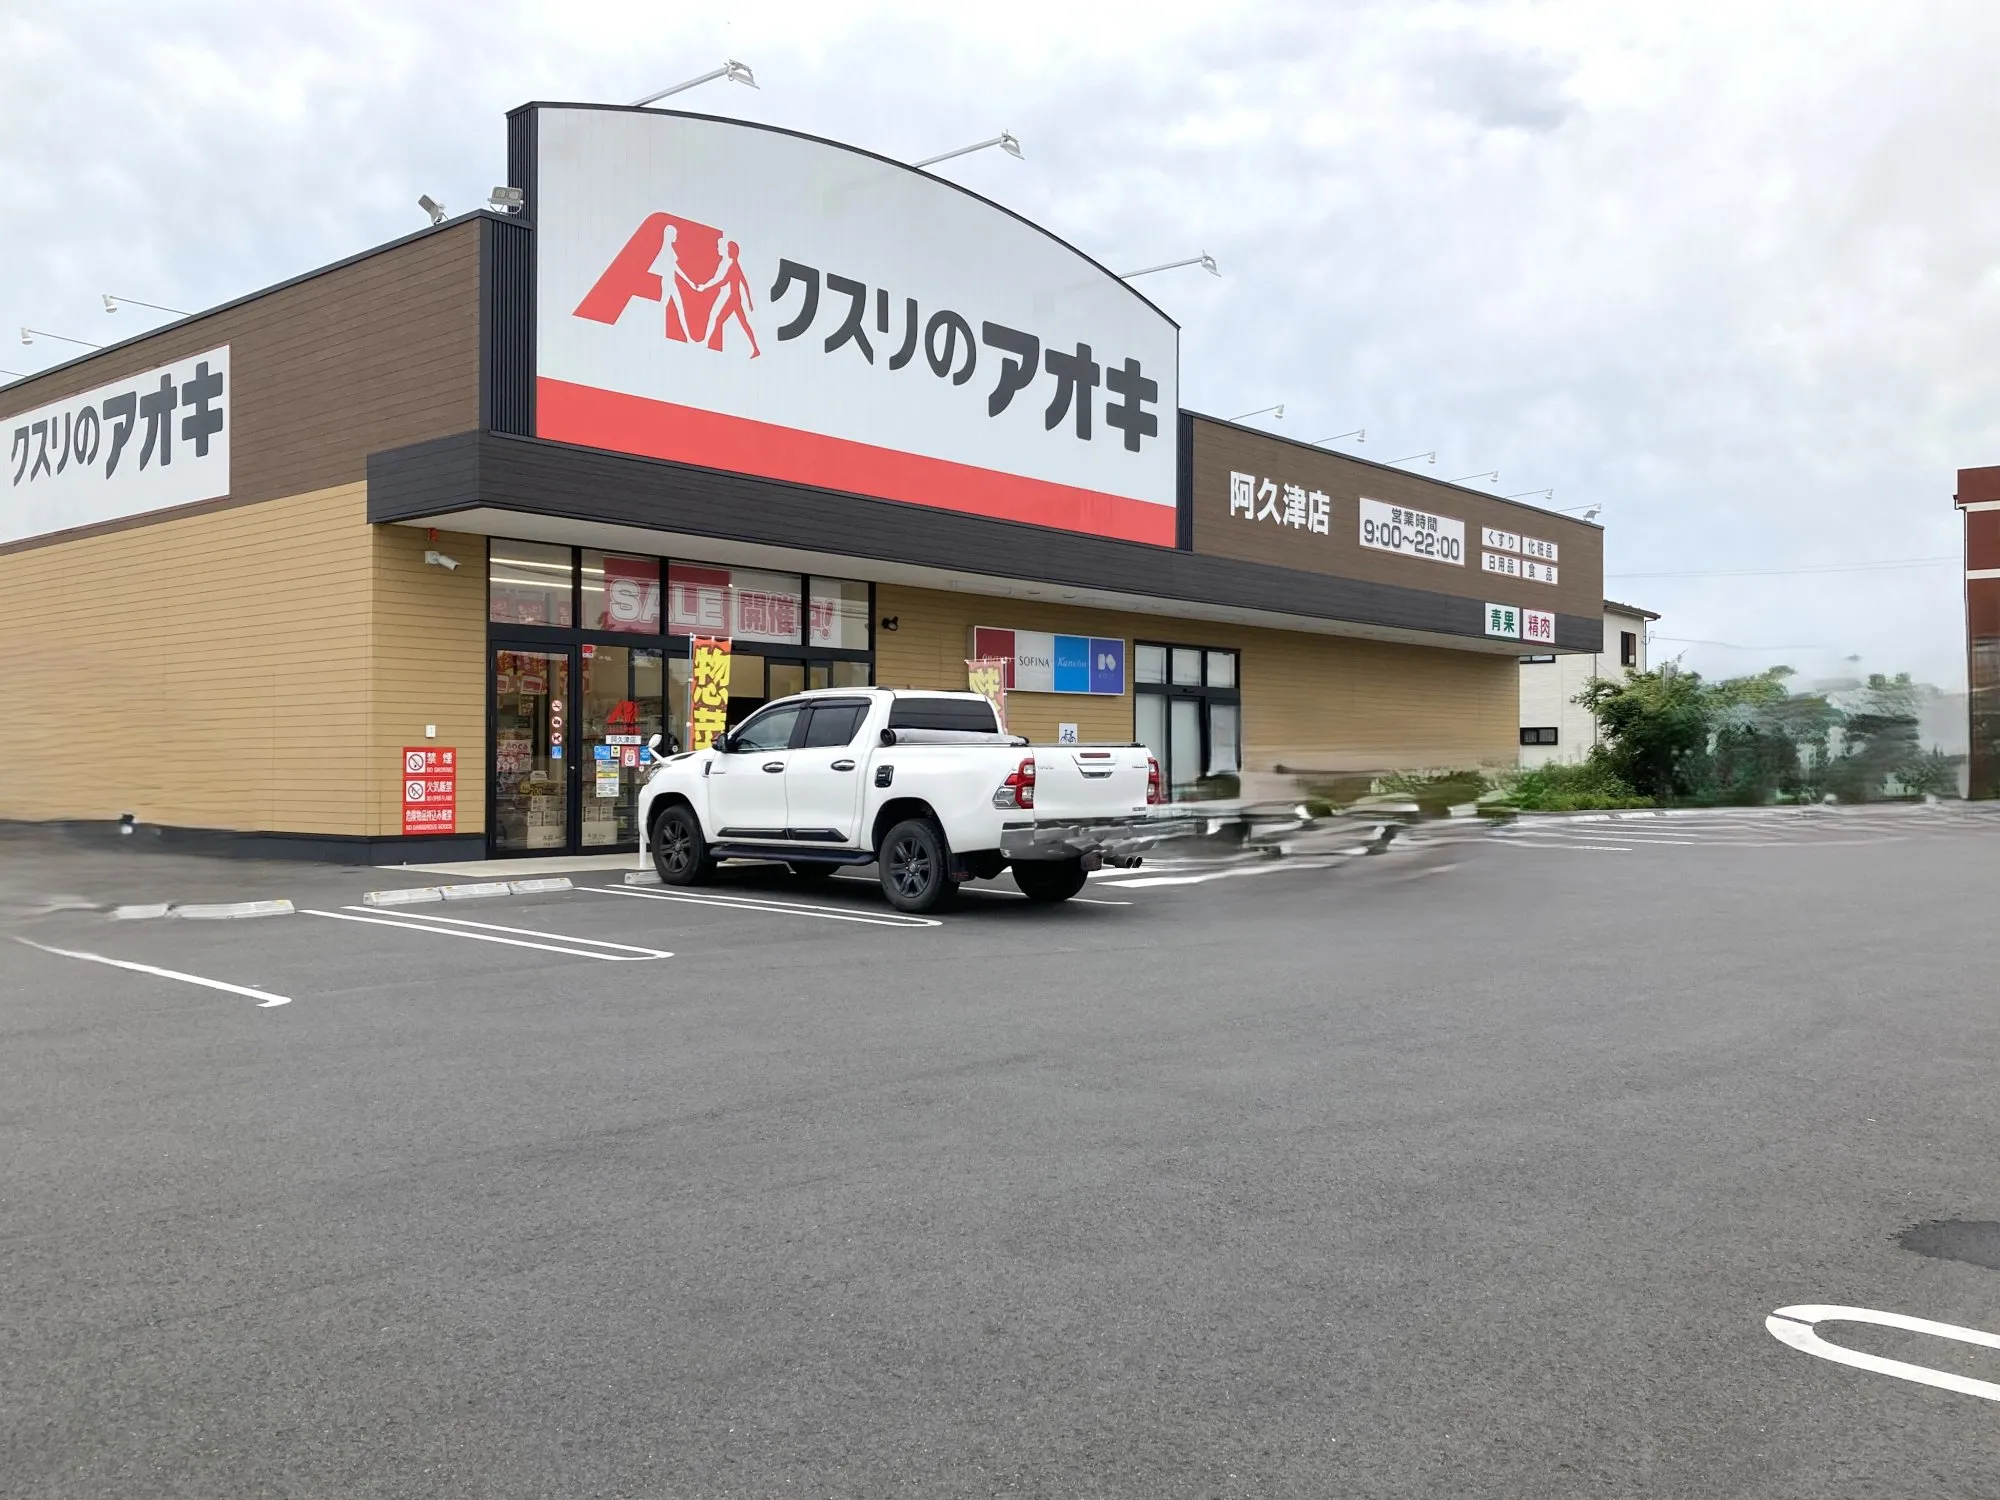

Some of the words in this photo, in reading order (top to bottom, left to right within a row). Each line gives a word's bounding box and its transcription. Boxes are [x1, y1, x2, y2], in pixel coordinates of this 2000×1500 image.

[770, 258, 1159, 453] クスリのアオキ
[11, 361, 223, 487] クスリのアオキ
[1230, 470, 1330, 536] 阿久津店
[1391, 507, 1437, 533] 営業時間
[1488, 530, 1514, 549] くすり
[1528, 540, 1552, 558] 化粧品
[1488, 555, 1514, 574] 日用品
[610, 579, 724, 629] SALE
[1491, 608, 1515, 633] 青果
[1528, 614, 1550, 639] 精肉
[1019, 655, 1050, 668] SOFINA
